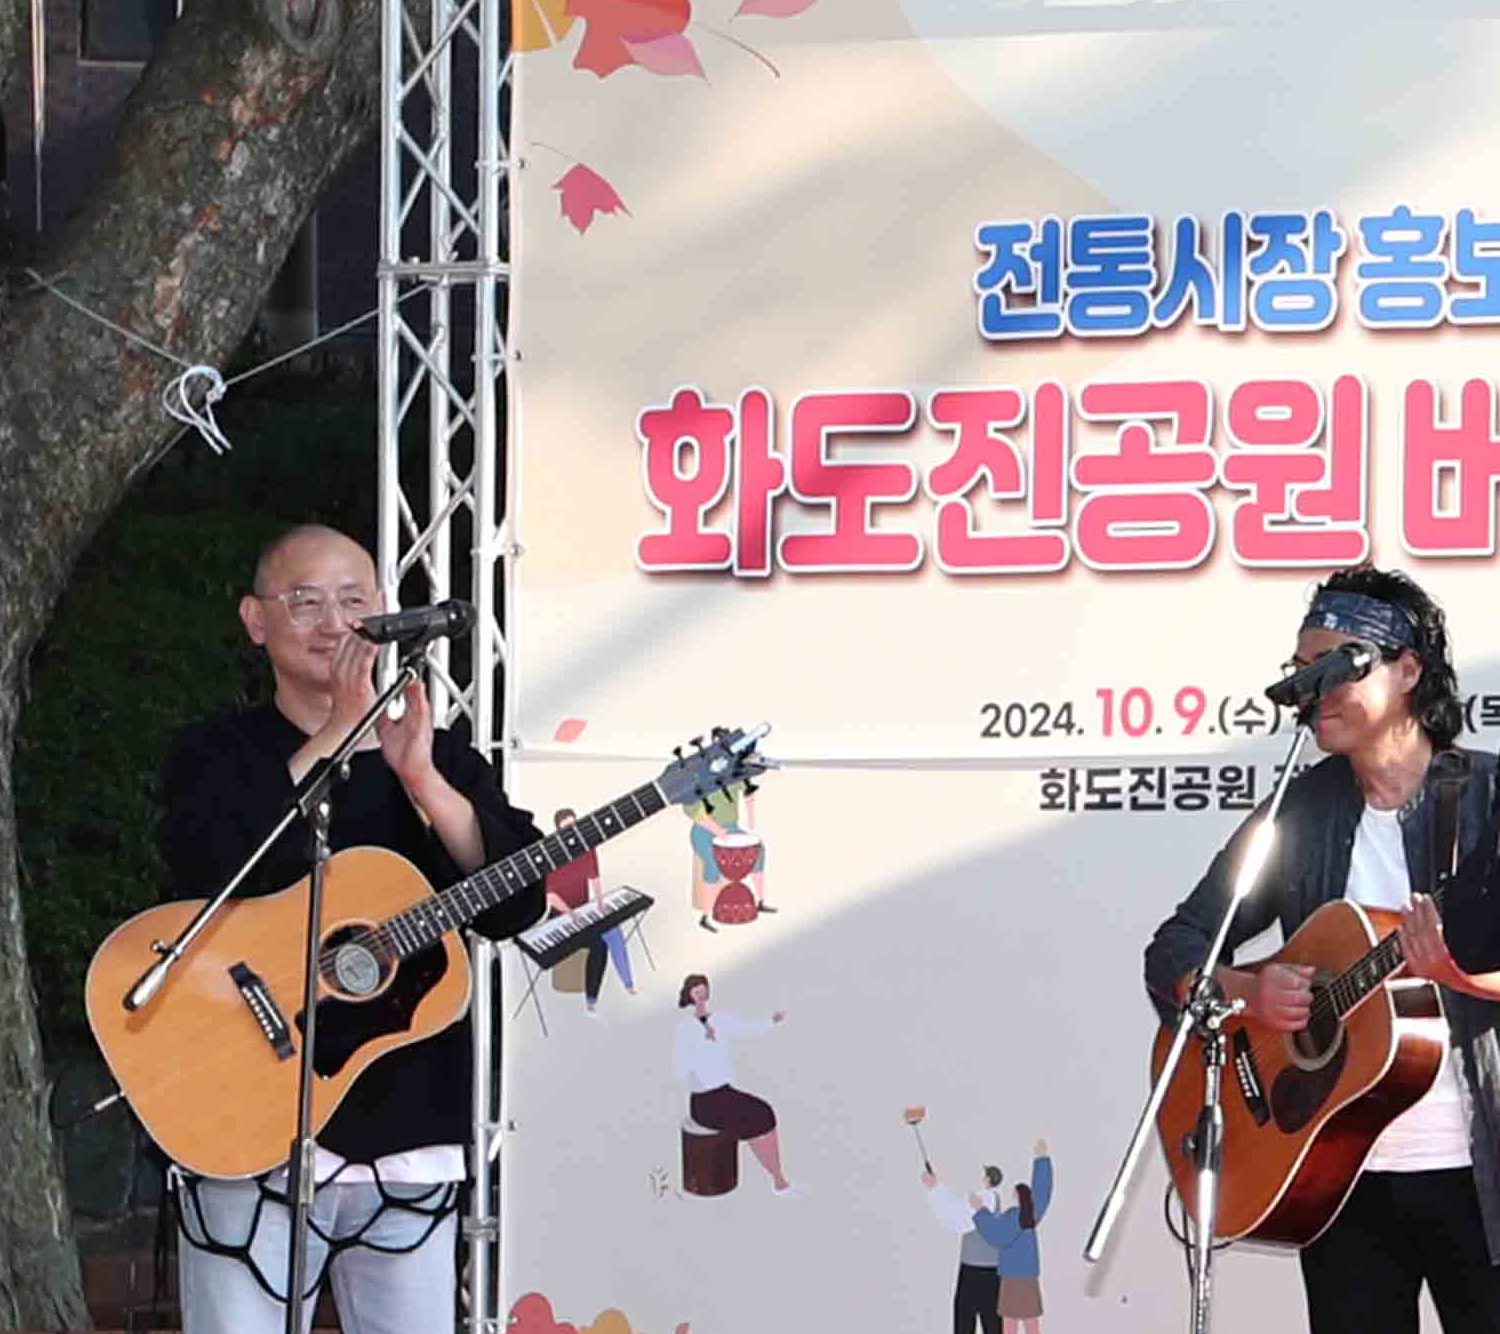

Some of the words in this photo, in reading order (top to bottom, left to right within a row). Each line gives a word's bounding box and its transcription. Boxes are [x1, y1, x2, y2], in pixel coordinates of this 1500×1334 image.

[973, 210, 1346, 340] 전통시장
[636, 373, 1371, 577] 화도진공원
[980, 700, 1085, 739] 2024.
[1039, 764, 1256, 814] 화도진공원
